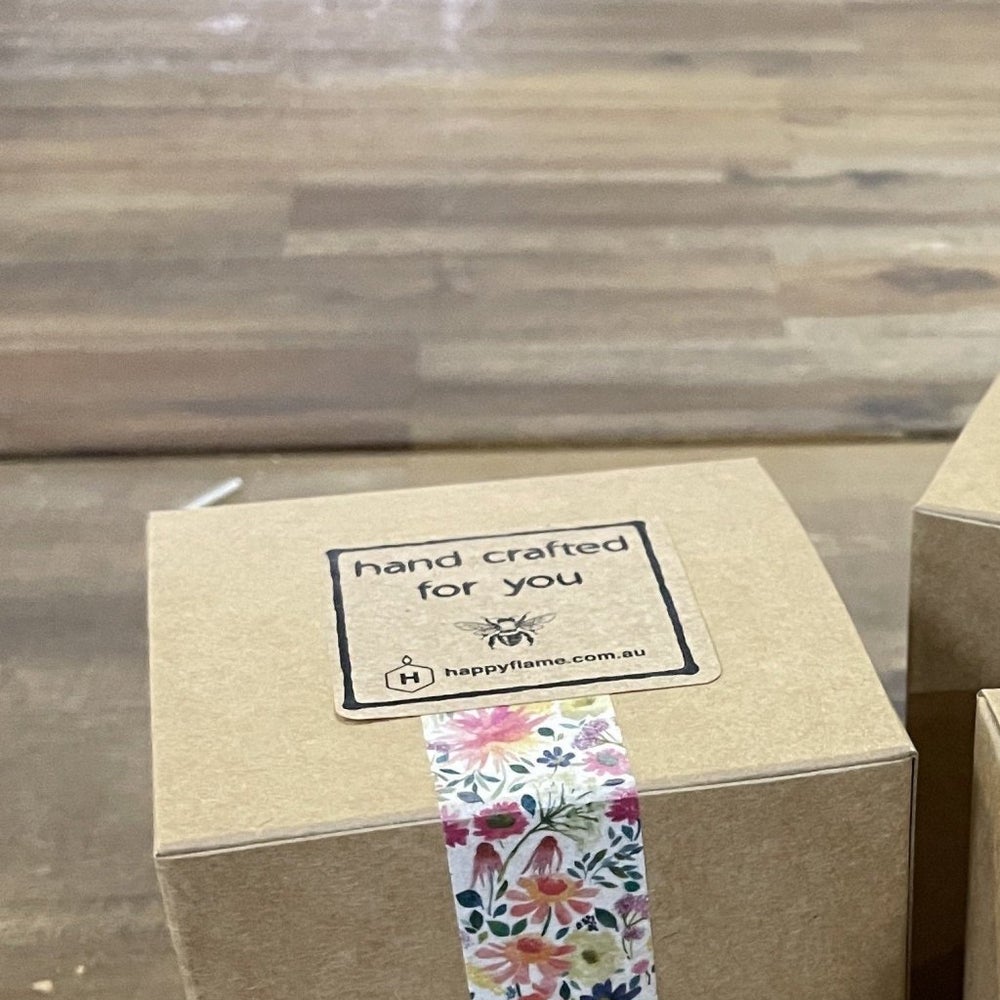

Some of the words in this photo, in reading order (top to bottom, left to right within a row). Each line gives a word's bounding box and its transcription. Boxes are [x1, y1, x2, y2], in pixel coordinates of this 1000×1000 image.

[354, 550, 462, 577] hand
[482, 535, 629, 564] crafted
[418, 578, 478, 600] for
[503, 571, 583, 597] you
[445, 648, 646, 678] happyflame.com.au
[400, 671, 420, 685] H
